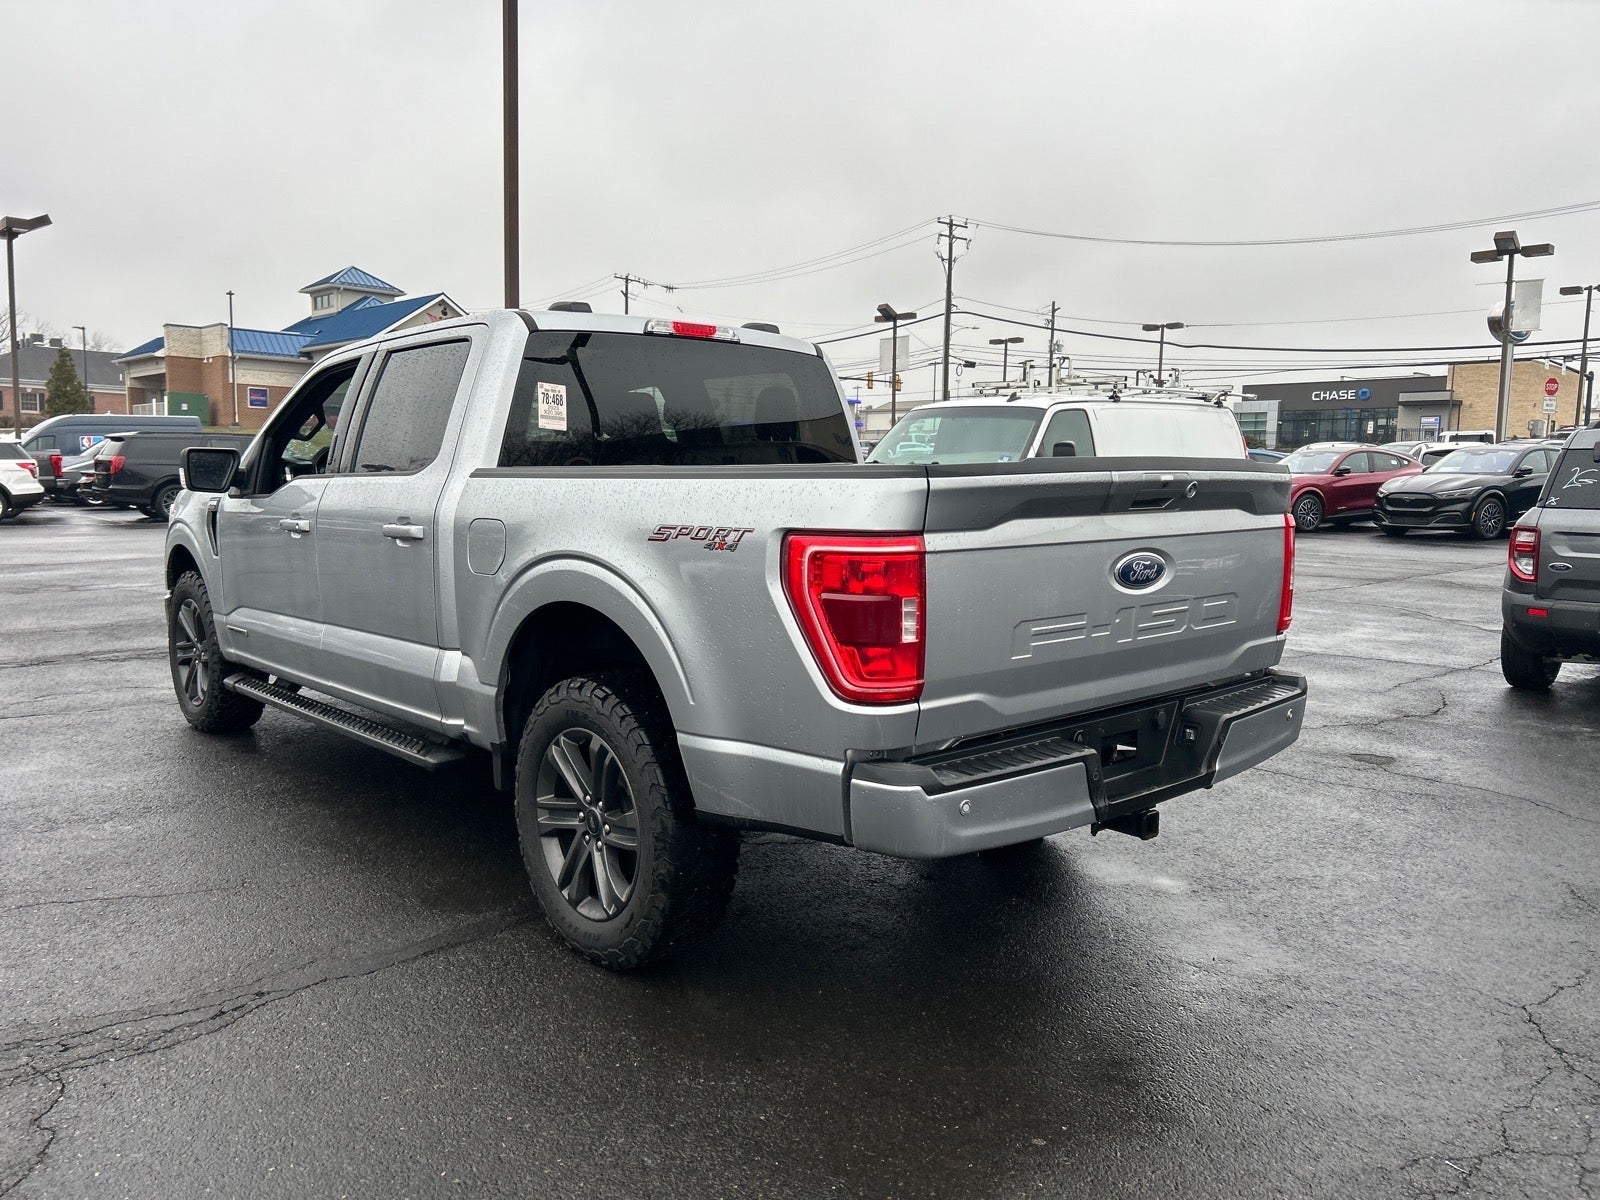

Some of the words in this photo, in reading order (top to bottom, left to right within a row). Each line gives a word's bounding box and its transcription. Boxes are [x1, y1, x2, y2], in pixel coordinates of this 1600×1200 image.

[1311, 390, 1357, 401] CHASE
[1546, 383, 1558, 391] STOP
[647, 524, 755, 543] SPORT
[1130, 560, 1158, 582] Ford
[1010, 592, 1240, 660] F-150
